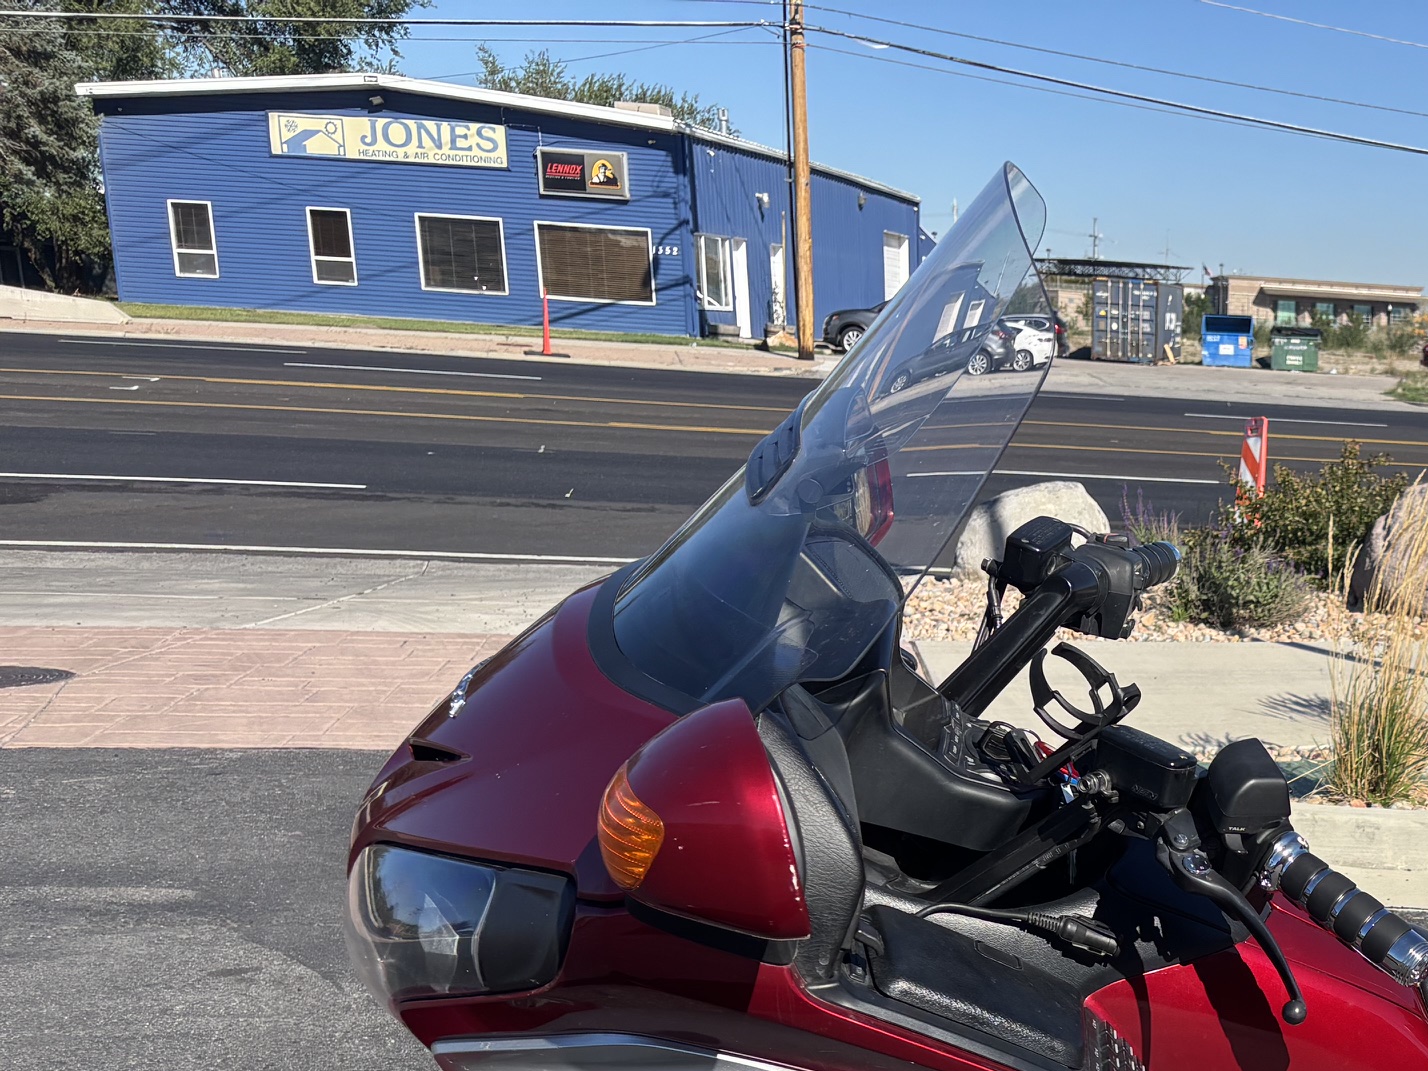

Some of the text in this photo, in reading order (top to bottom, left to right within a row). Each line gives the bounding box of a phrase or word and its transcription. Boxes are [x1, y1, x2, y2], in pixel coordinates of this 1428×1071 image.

[360, 119, 499, 153] JONES
[358, 149, 399, 159] HEATING
[414, 152, 430, 160] AIR
[433, 153, 503, 165] CONDITIONING
[546, 163, 583, 174] LENNOX
